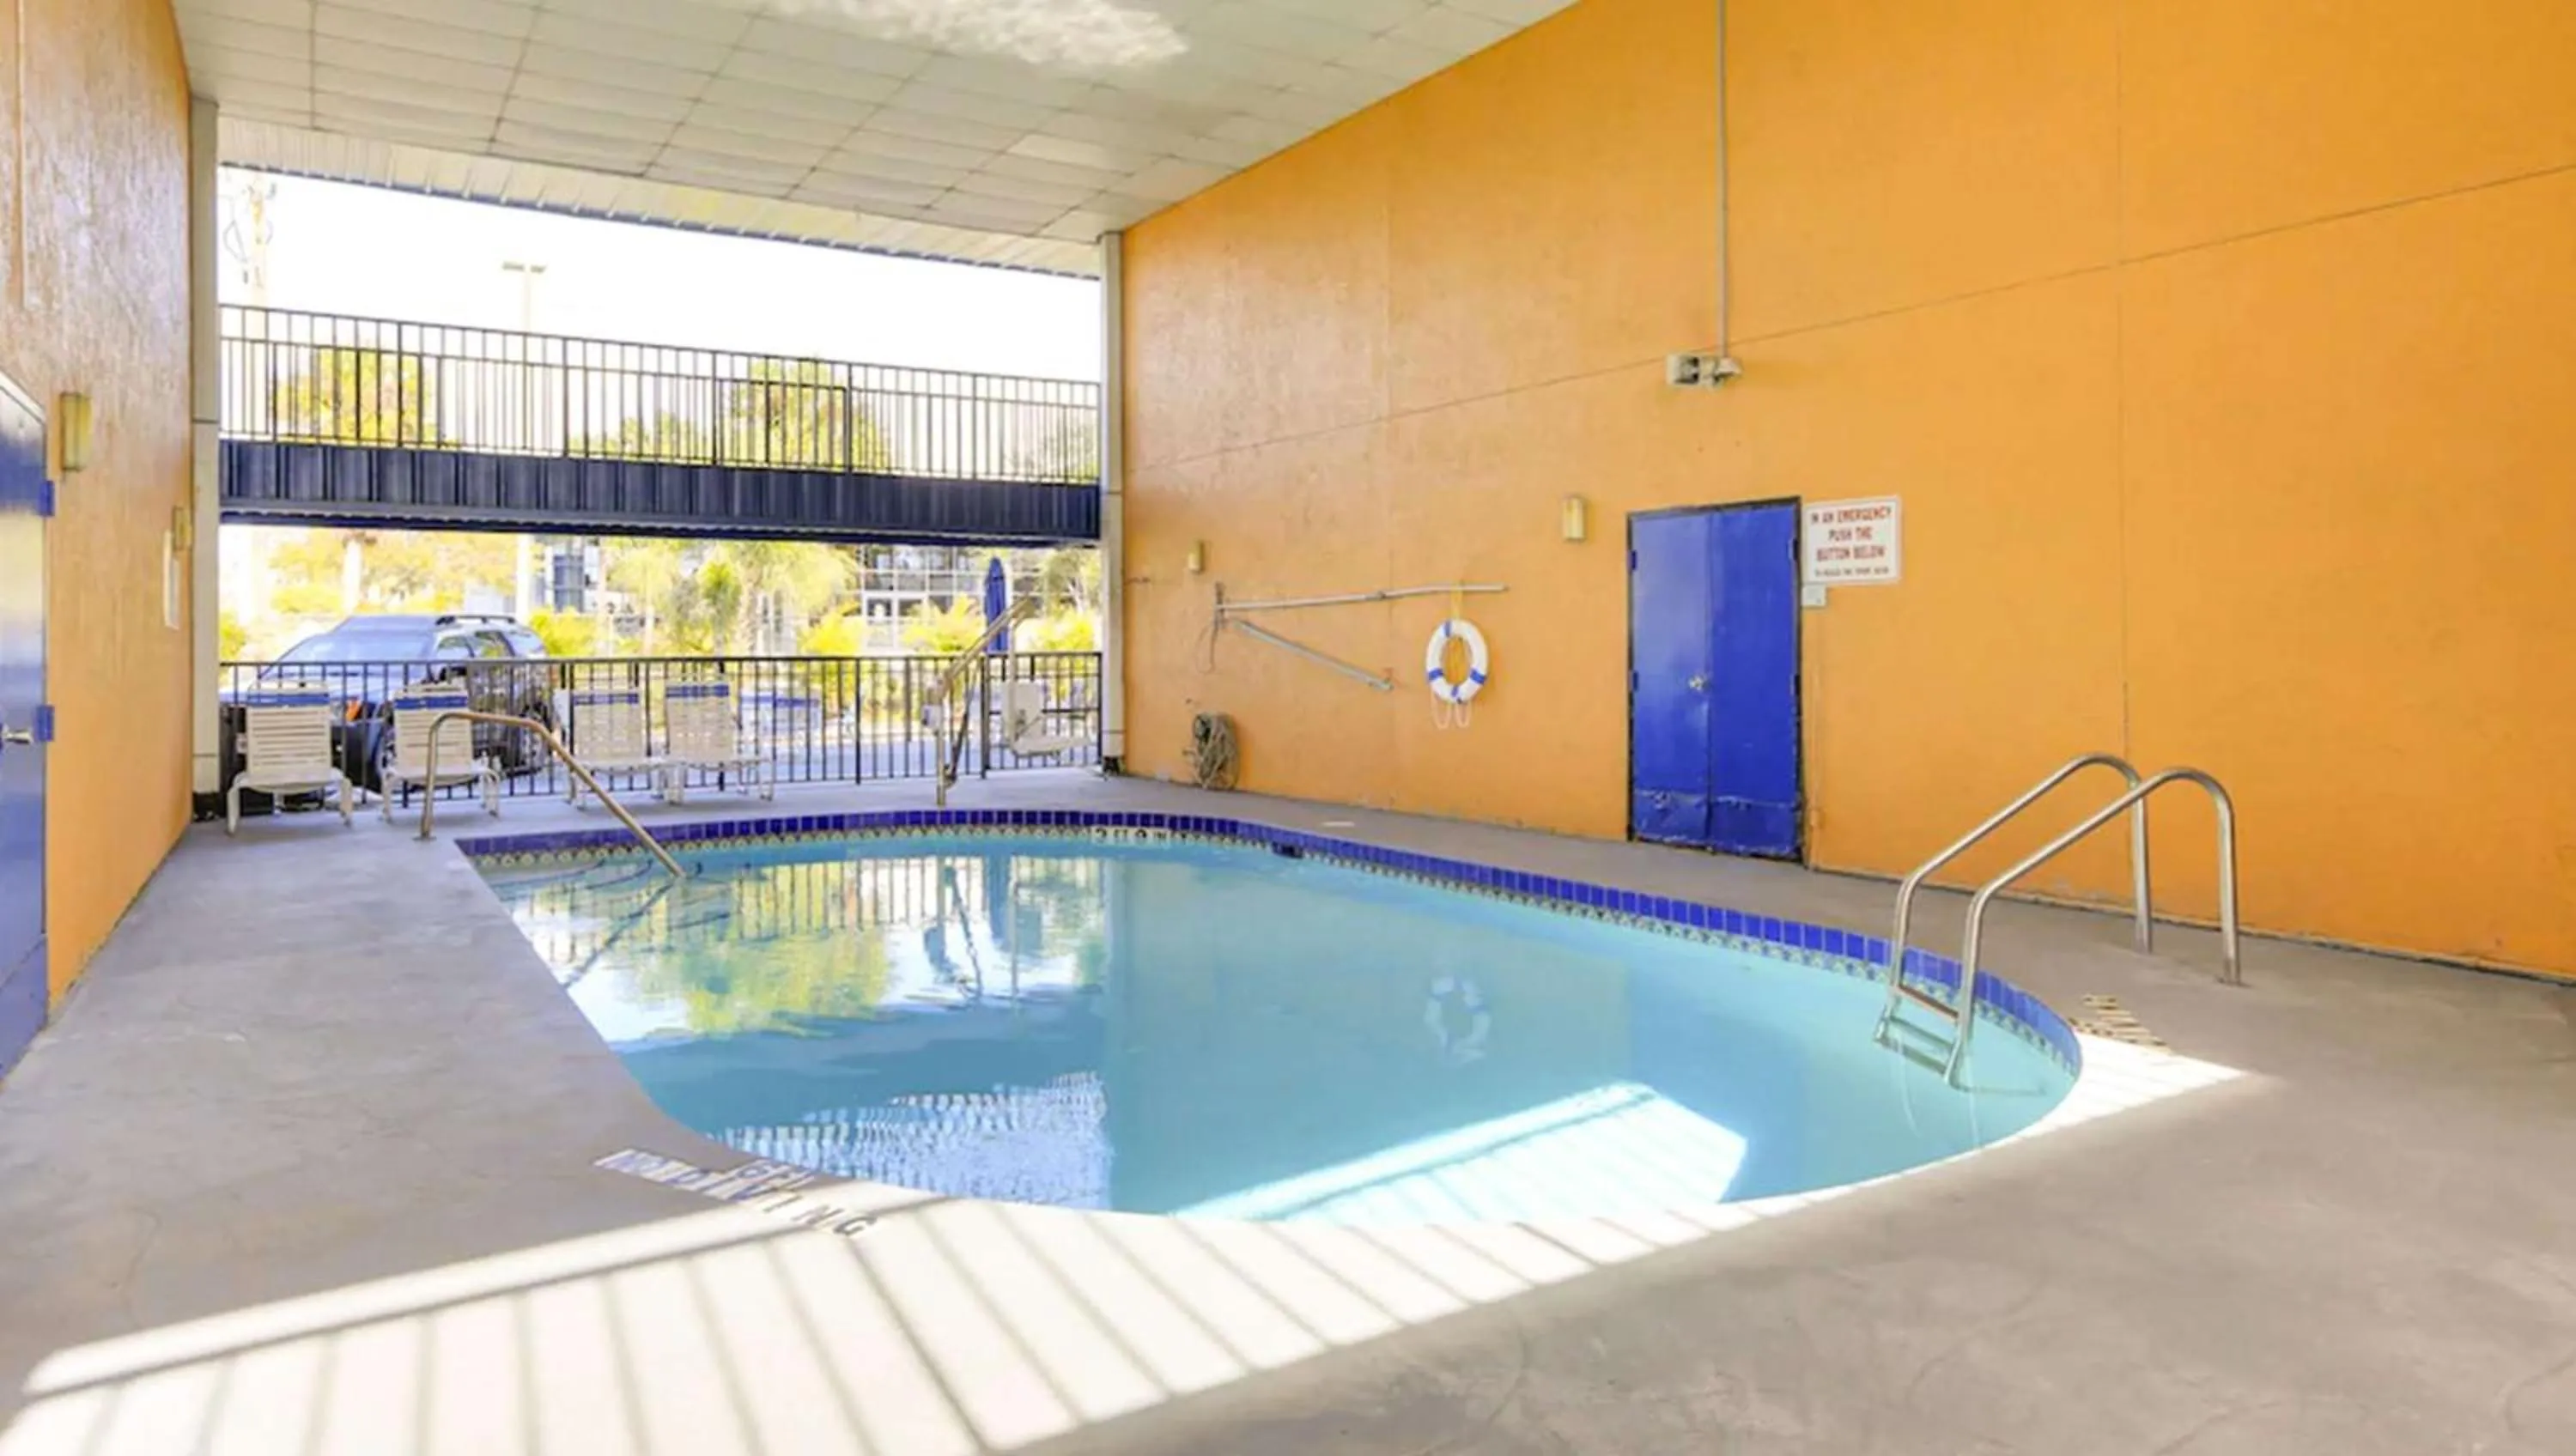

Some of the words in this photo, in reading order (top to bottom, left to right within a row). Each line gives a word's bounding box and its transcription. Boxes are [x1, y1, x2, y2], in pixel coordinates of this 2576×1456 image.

[1838, 506, 1892, 523] EMERGENCY
[1828, 529, 1852, 542] PUSH
[1856, 526, 1873, 541] THE
[1817, 547, 1850, 561] BUTTON
[1853, 544, 1886, 559] BELOW
[665, 1165, 881, 1236] DIVING
